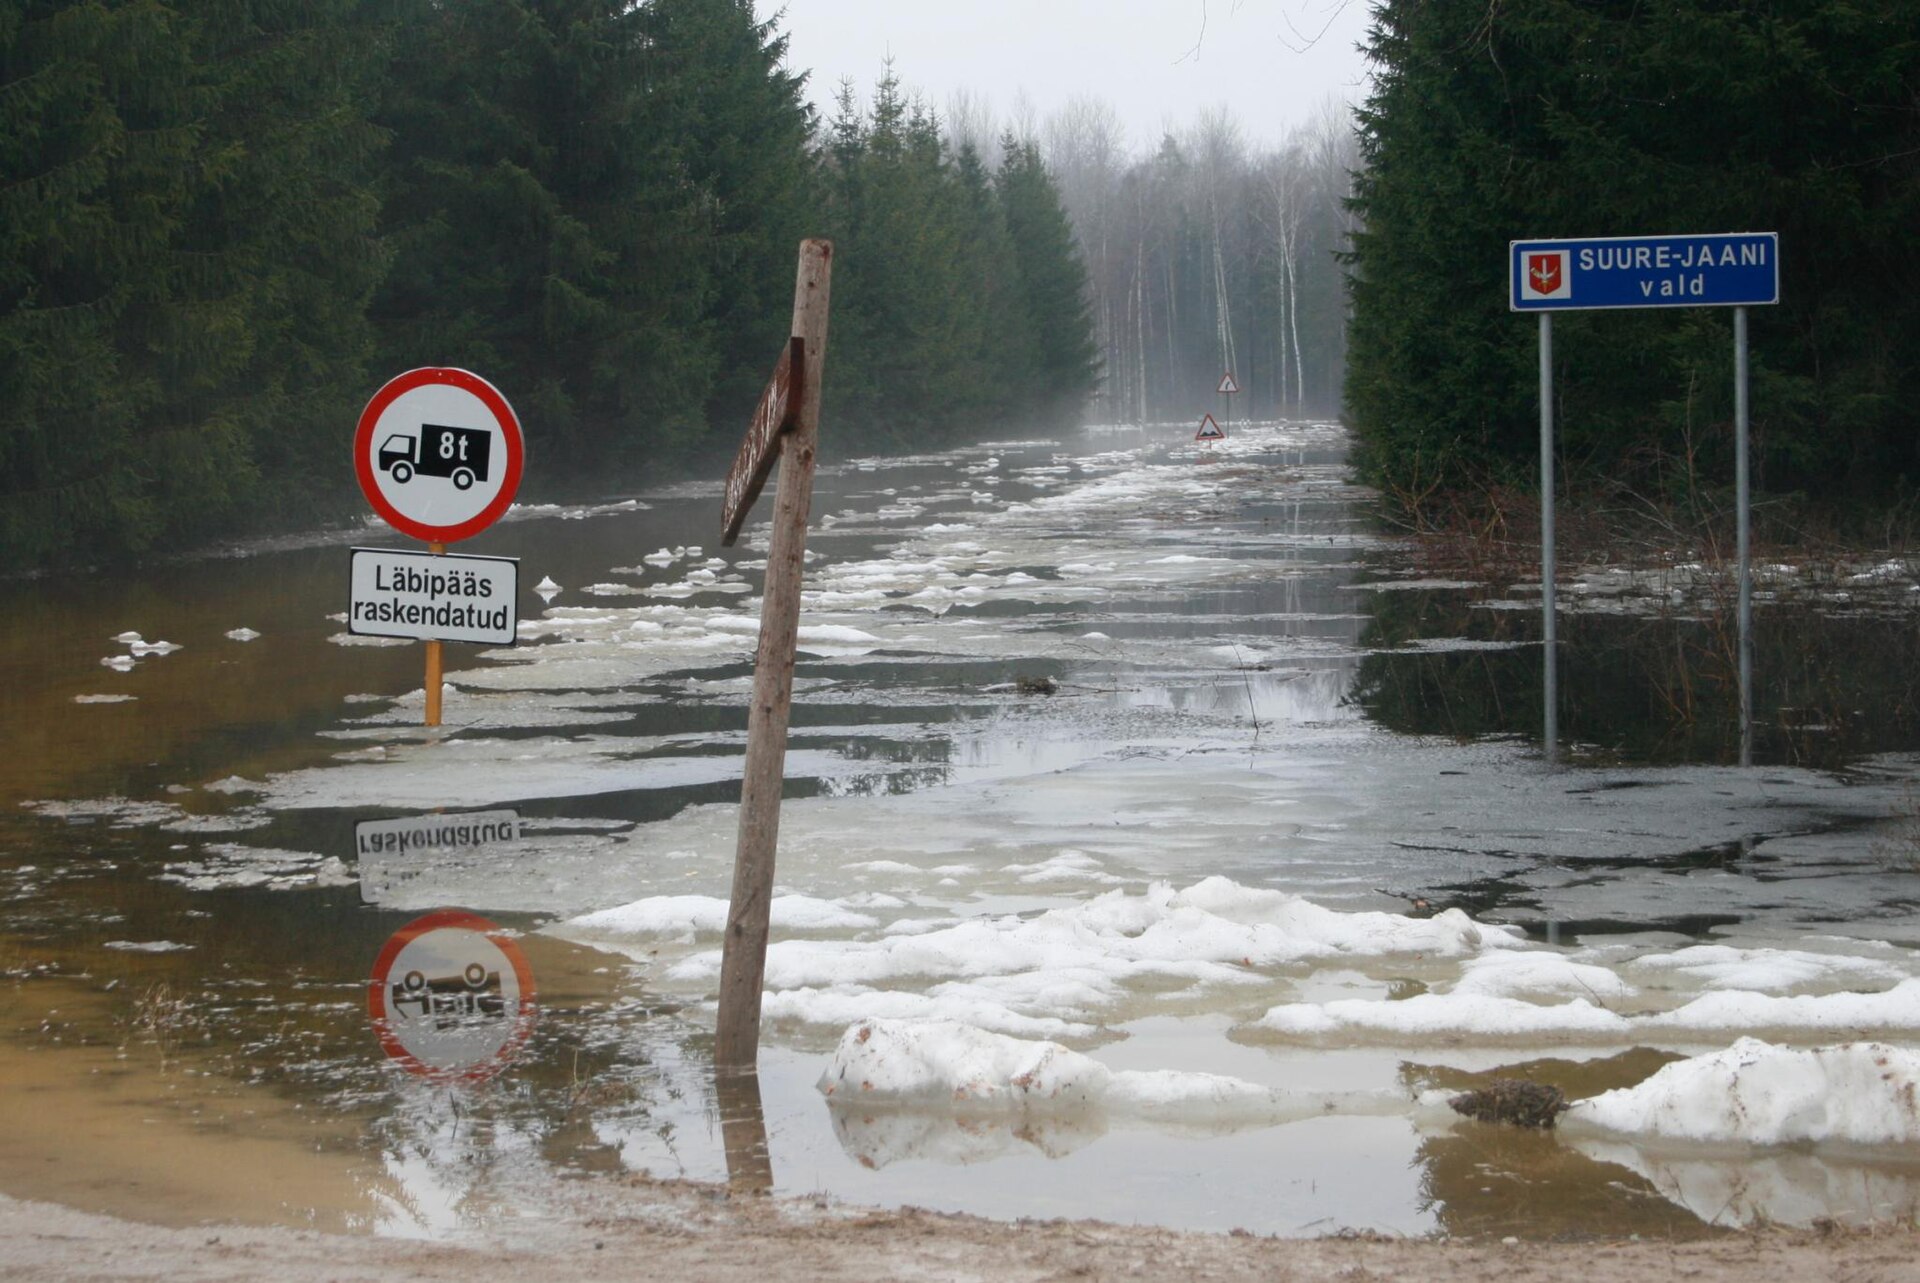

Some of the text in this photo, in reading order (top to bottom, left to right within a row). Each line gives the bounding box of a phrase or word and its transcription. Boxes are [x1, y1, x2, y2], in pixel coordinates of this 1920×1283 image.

[1579, 243, 1766, 271] SUURE-JAANI
[1640, 273, 1704, 297] vald
[376, 565, 492, 601] Läbipääs
[354, 598, 507, 631] raskendatud
